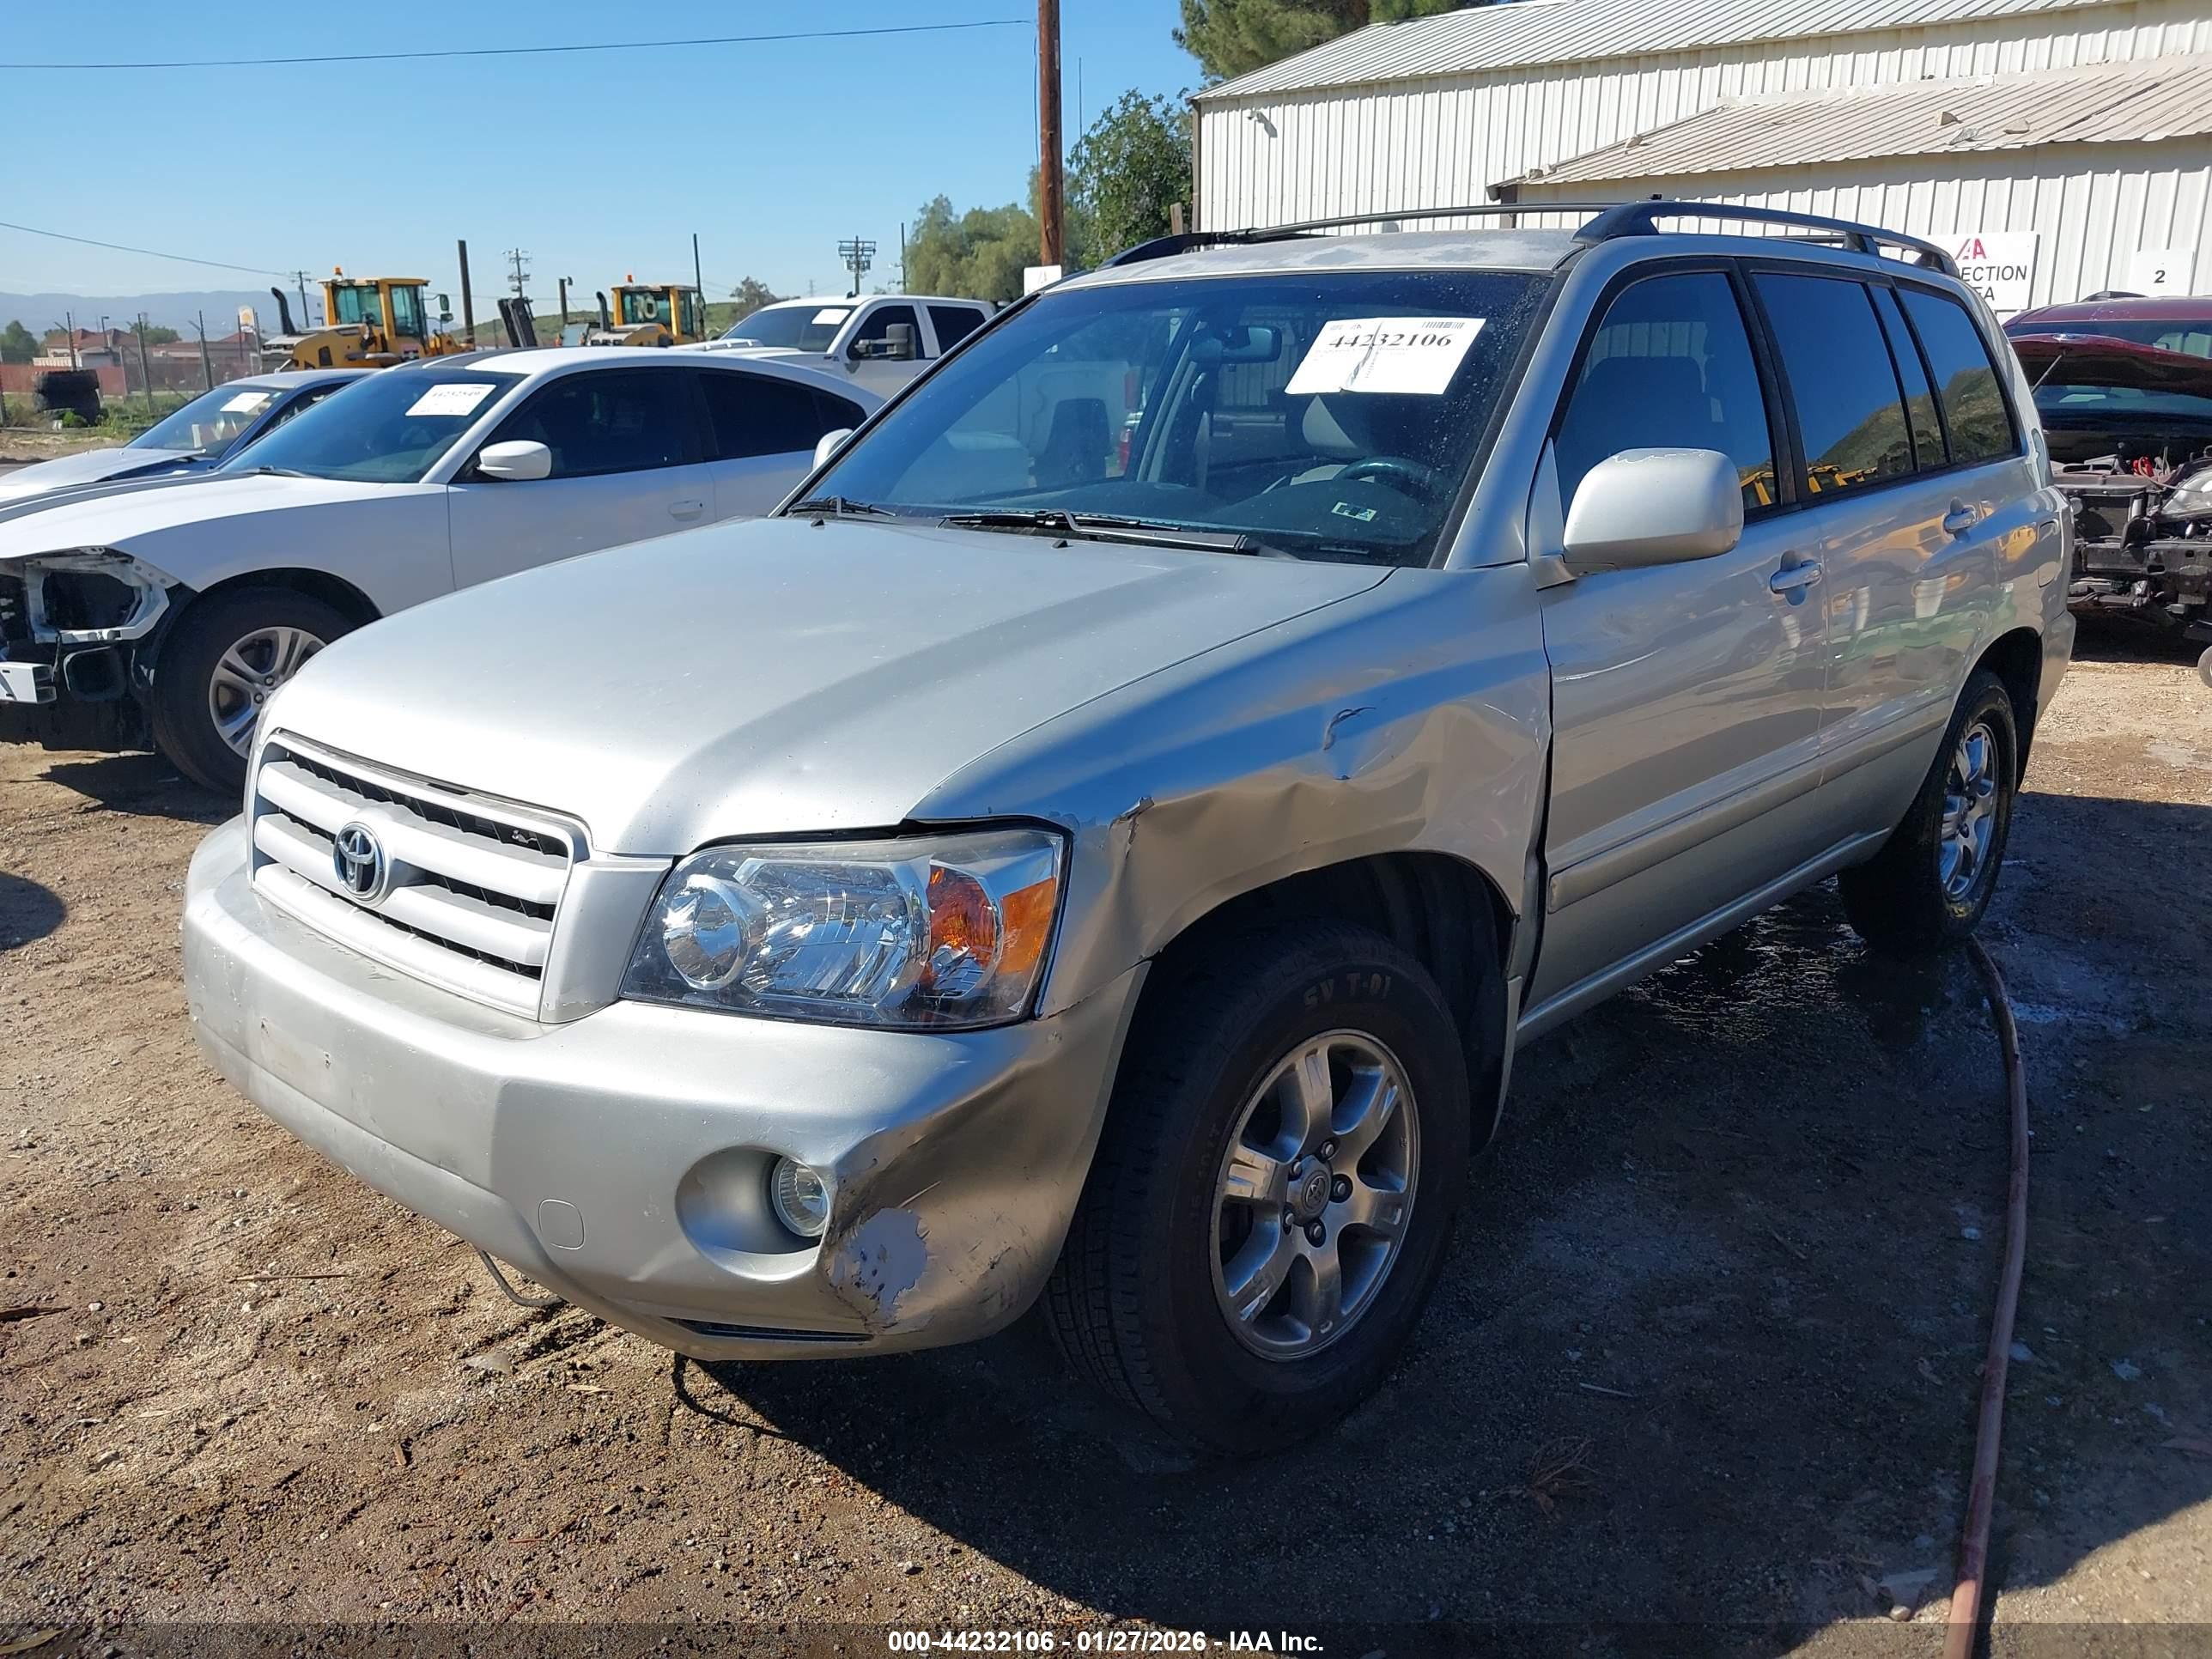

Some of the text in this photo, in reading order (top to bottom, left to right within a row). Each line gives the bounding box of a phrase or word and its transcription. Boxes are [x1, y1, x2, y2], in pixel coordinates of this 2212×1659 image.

[1961, 265, 2027, 282] ECTION
[2154, 270, 2166, 283] 2
[1328, 332, 1455, 348] 44232106
